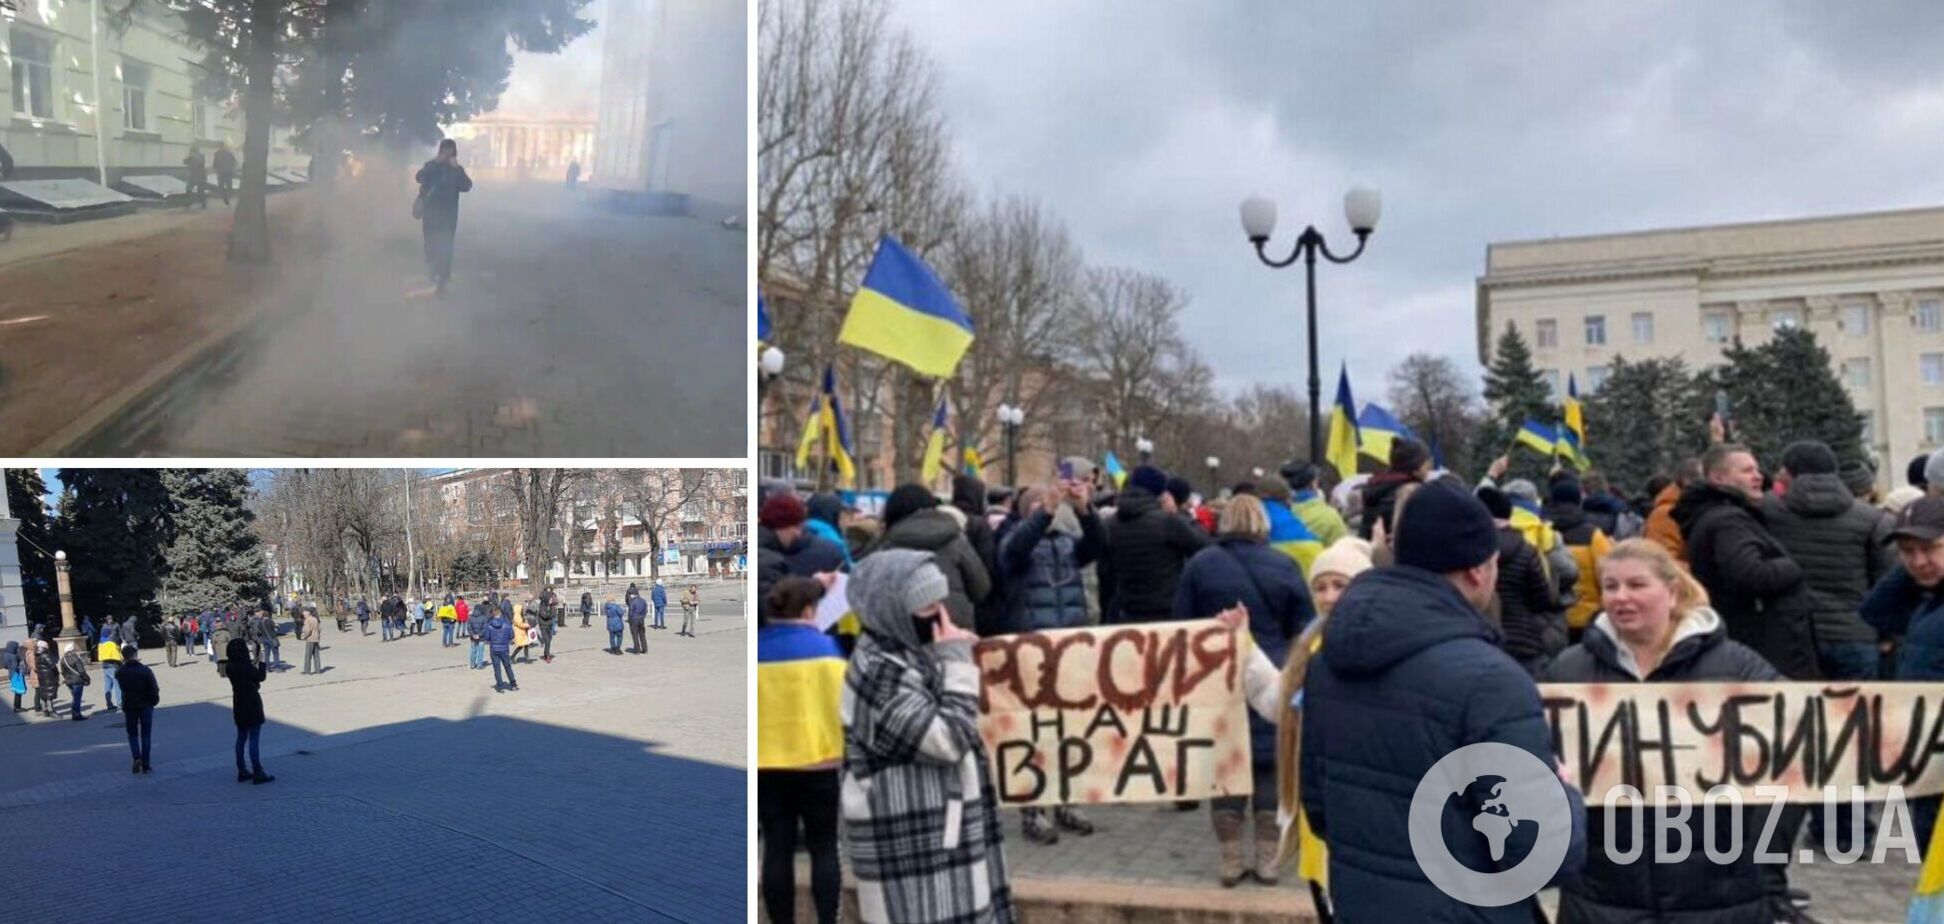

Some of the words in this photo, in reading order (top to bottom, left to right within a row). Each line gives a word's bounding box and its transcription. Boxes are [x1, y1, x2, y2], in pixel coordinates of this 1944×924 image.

[973, 628, 1237, 714] РОССИЯ
[1031, 703, 1188, 742] НАШ
[996, 736, 1214, 801] ВРАГ
